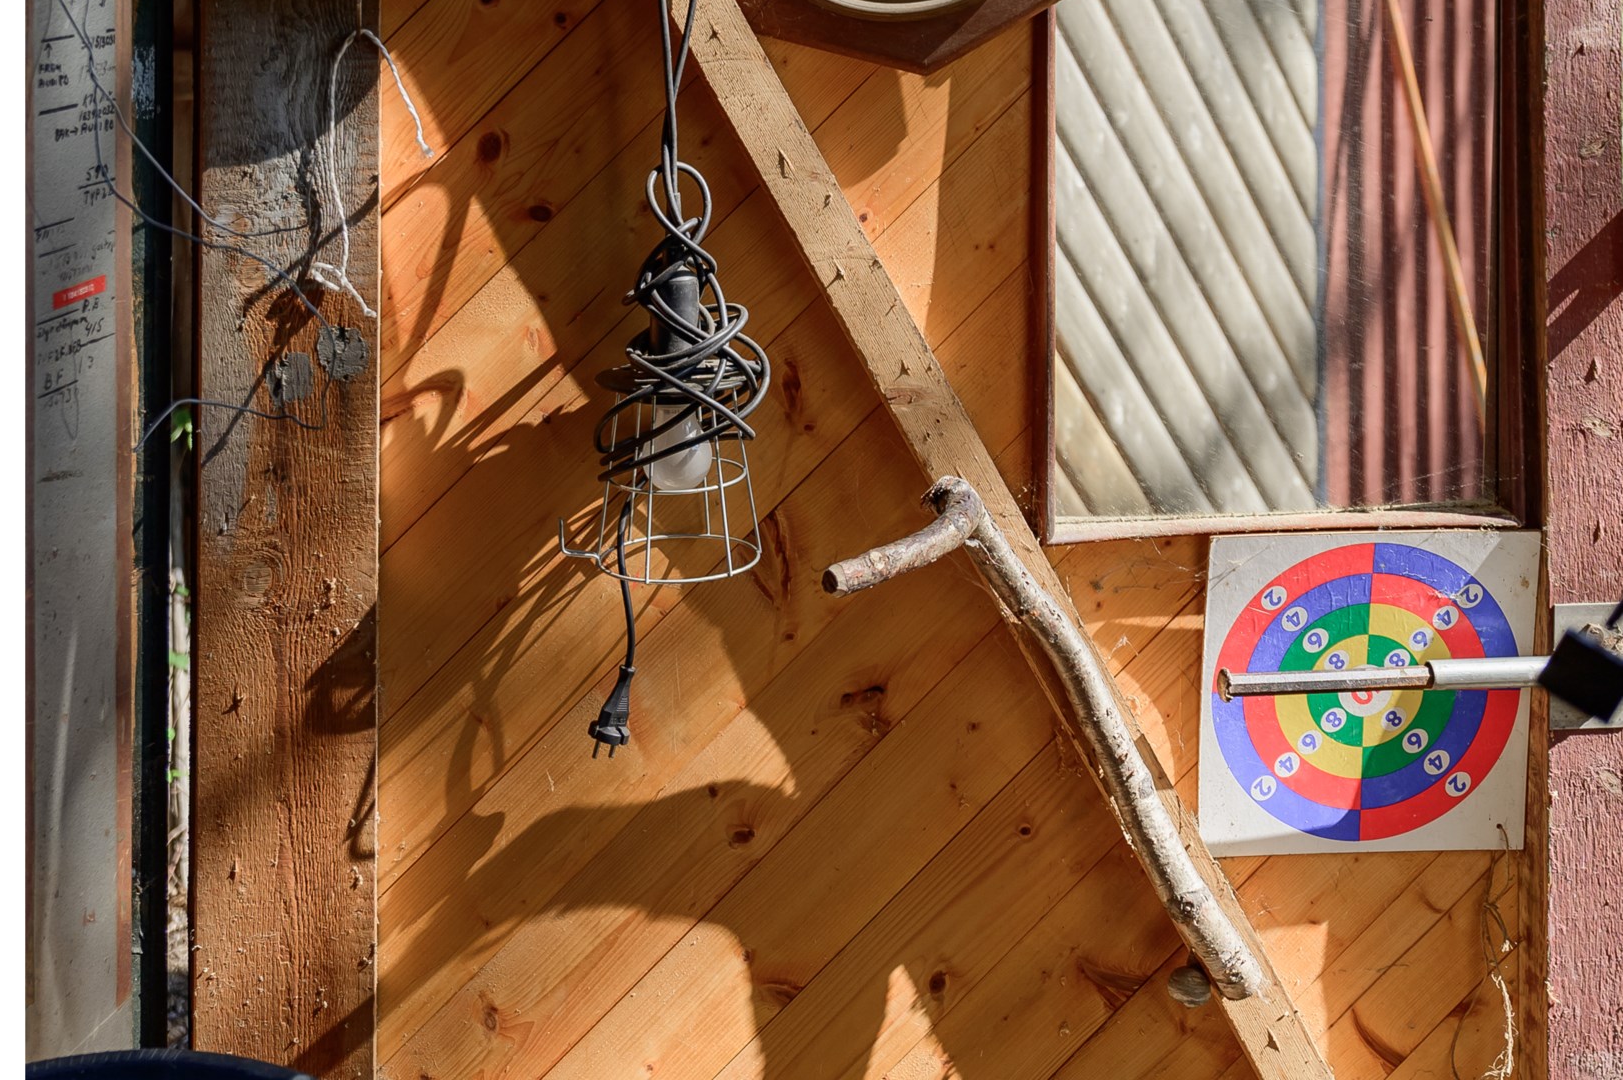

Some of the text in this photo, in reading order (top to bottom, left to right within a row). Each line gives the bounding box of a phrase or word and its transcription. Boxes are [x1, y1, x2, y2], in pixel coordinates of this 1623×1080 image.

[1264, 589, 1282, 607] 2
[1460, 587, 1479, 604] 2
[1285, 611, 1301, 627] 4
[1436, 610, 1452, 627] 4
[1328, 653, 1345, 670] 8
[1388, 652, 1406, 667] 8
[1325, 711, 1343, 729] 8
[1385, 710, 1403, 728] 8
[1278, 756, 1295, 774] 4
[1427, 754, 1444, 772] 4
[1254, 779, 1272, 797] 2
[1447, 774, 1467, 793] 2
